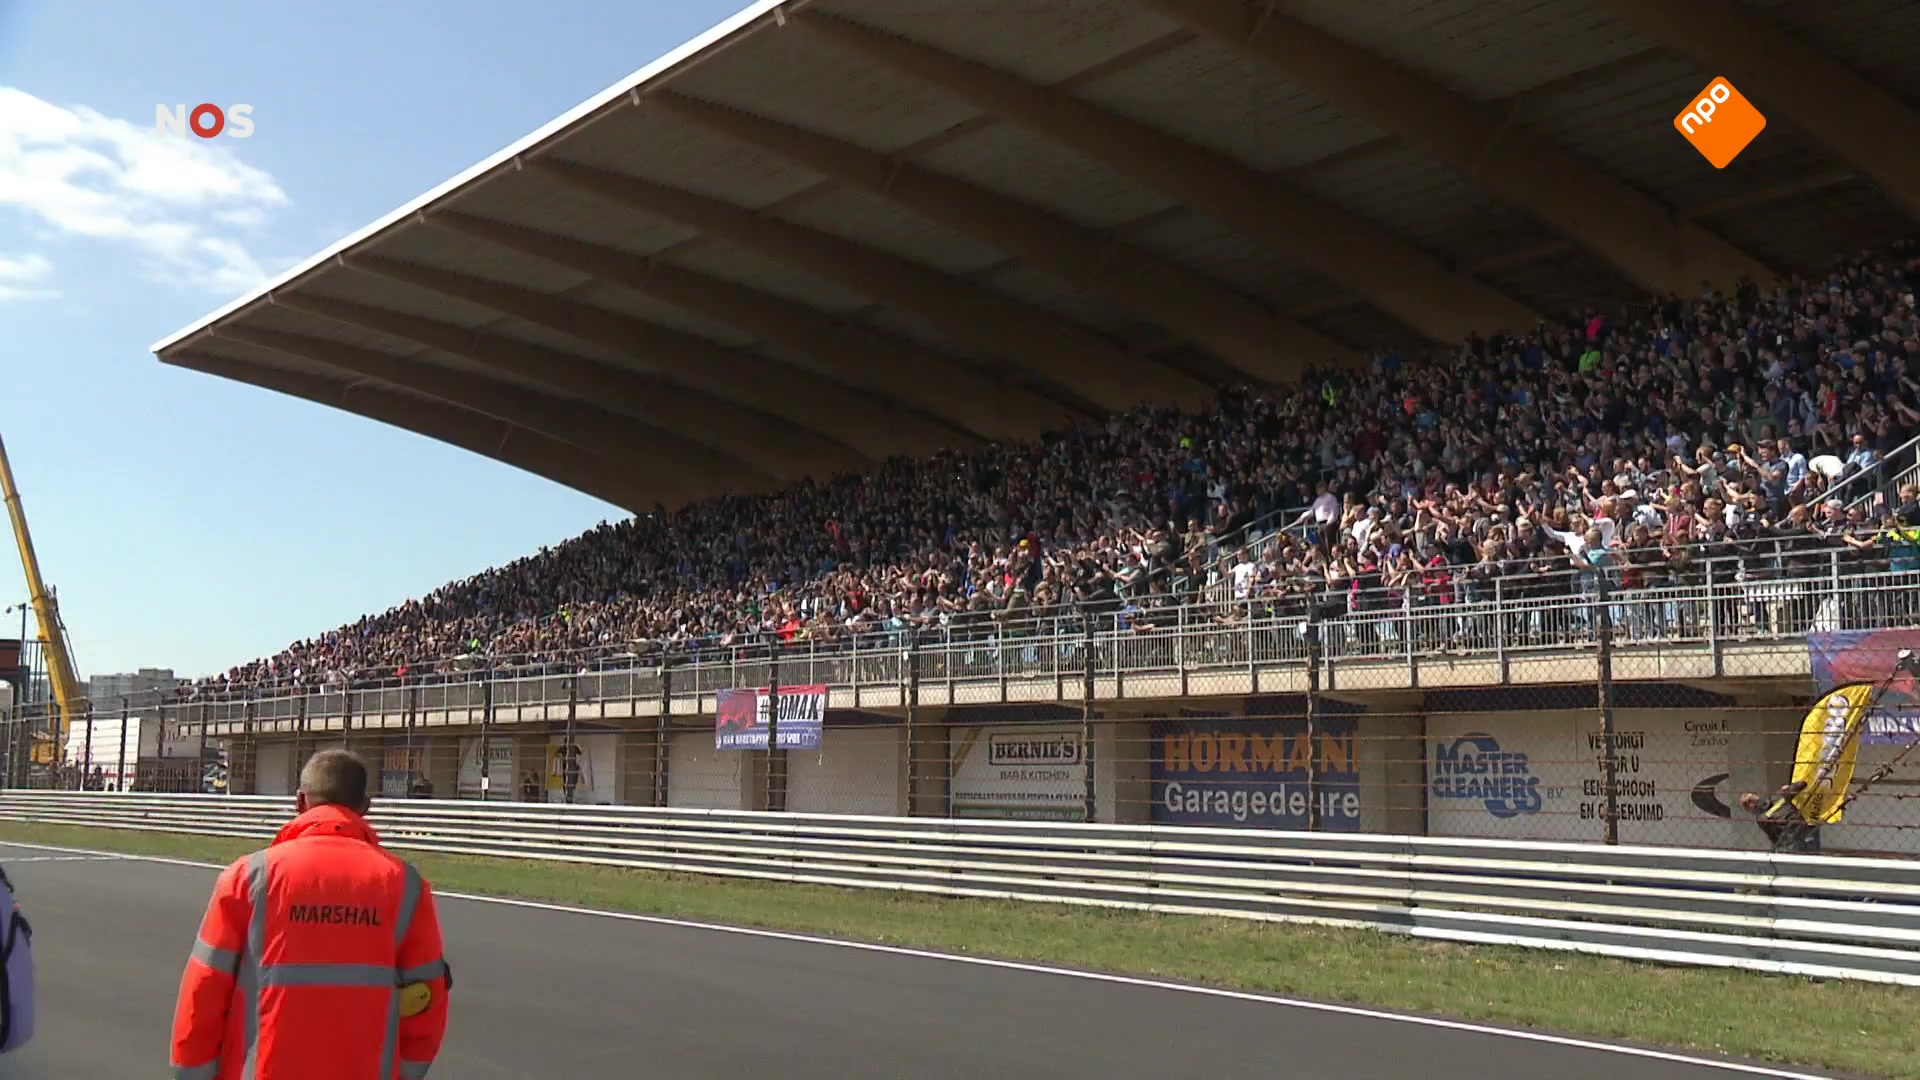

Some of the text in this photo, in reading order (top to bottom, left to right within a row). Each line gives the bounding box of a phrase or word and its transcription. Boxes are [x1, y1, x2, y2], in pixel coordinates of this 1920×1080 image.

[759, 694, 819, 720] #OMAX
[994, 736, 1075, 759] BERNIE'S
[1588, 732, 1645, 750] VEORGT
[1435, 743, 1529, 775] MASTER
[1631, 755, 1640, 773] U
[1432, 777, 1542, 812] CLEANERS
[1606, 780, 1656, 798] CHOON
[1580, 802, 1664, 821] EN OGERUIMD
[289, 905, 382, 927] MARSHAL
